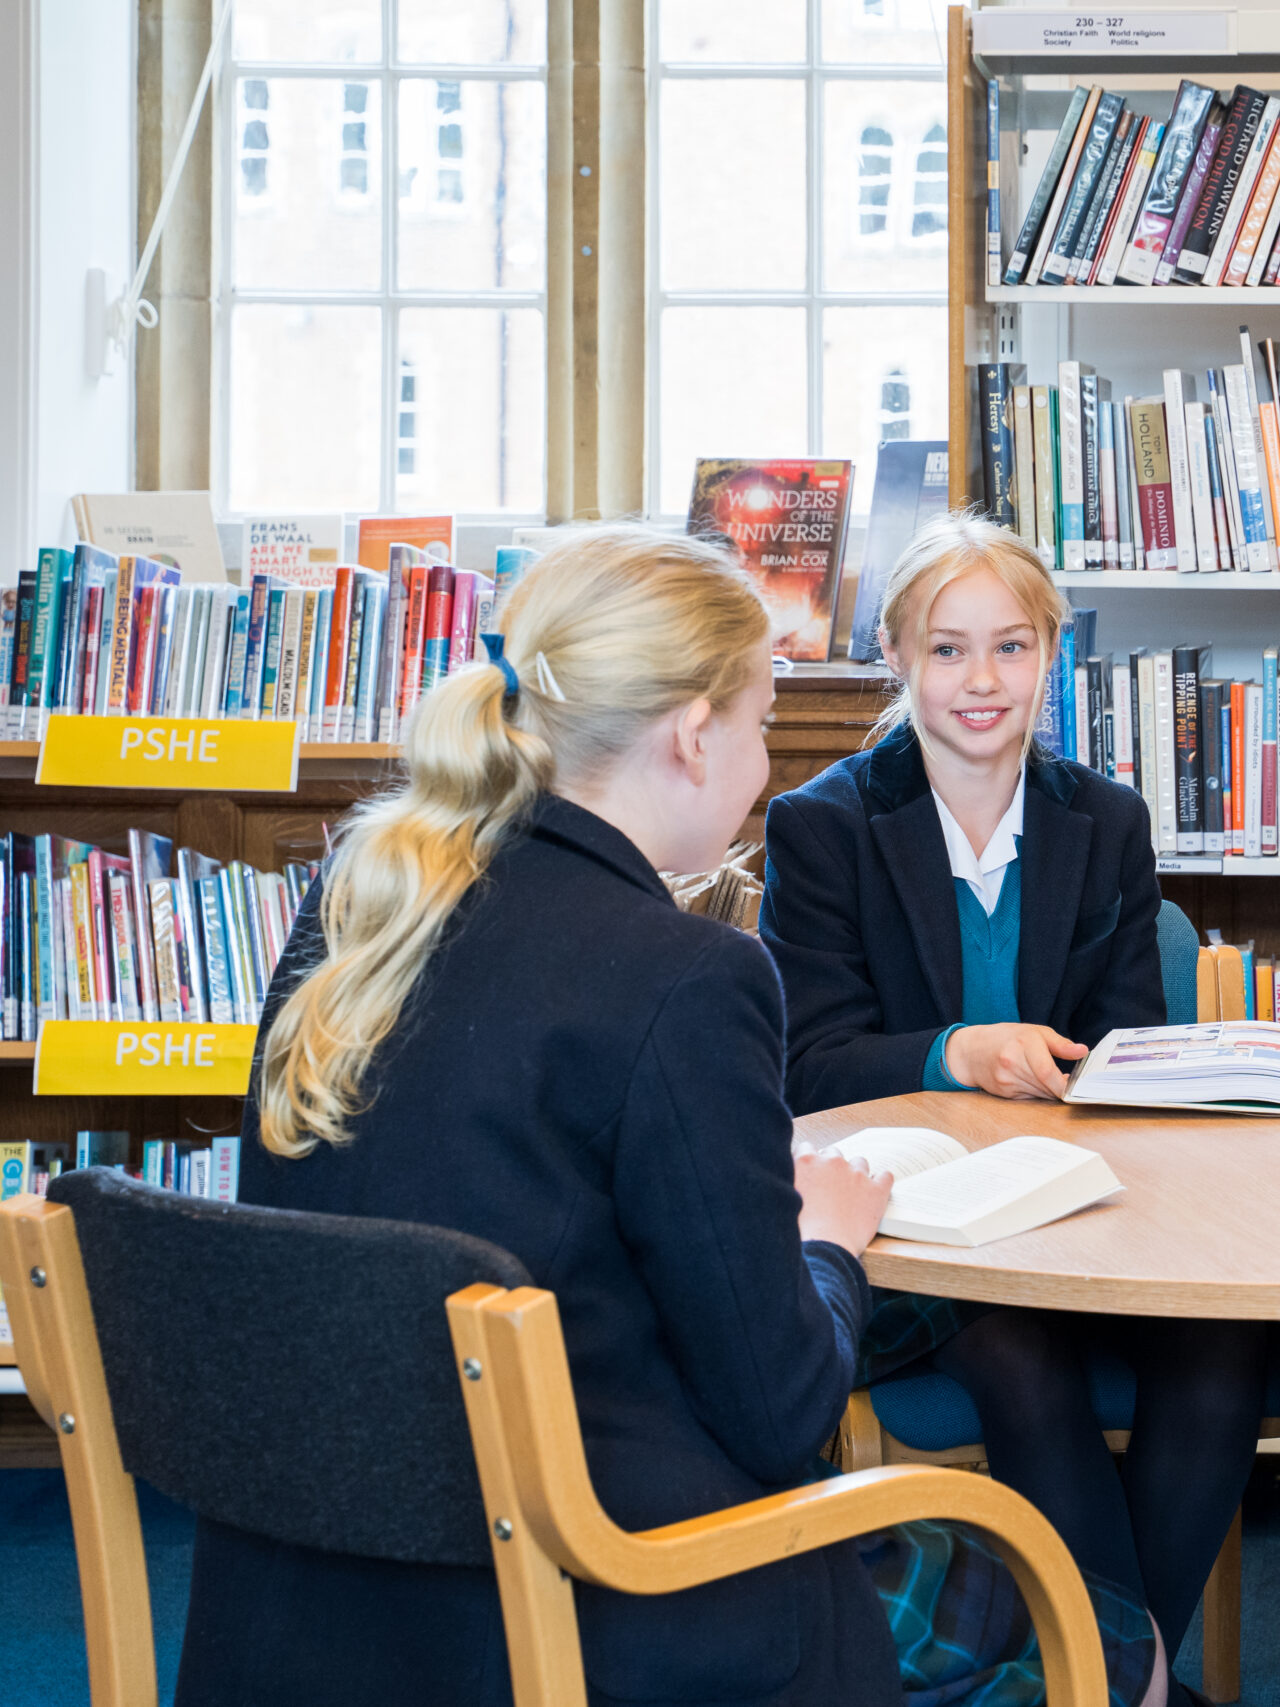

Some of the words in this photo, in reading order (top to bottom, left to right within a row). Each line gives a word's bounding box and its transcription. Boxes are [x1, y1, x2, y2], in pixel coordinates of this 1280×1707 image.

[1075, 18, 1094, 27] 230
[1106, 18, 1124, 27] 327
[1133, 30, 1165, 38] religions
[1044, 39, 1072, 47] Society
[1230, 91, 1250, 119] THE
[1216, 121, 1240, 158] GOD
[1229, 96, 1266, 166] RICHARD
[1190, 158, 1227, 231] DELUSION
[1205, 168, 1240, 237] DAWKINS
[986, 392, 1002, 434] Heresy
[1137, 413, 1154, 479] HOLLAND
[1152, 435, 1161, 455] TOM
[1084, 441, 1095, 490] CHRISTIAN
[790, 510, 808, 522] OF
[810, 510, 836, 522] THE
[1086, 491, 1097, 524] ETHICS
[251, 523, 297, 531] FRANS
[251, 534, 267, 544] DE
[275, 534, 312, 543] WAAL
[726, 523, 834, 542] UNIVERSE
[250, 556, 297, 565] SMART
[251, 545, 276, 554] ARE
[283, 545, 302, 554] WE
[760, 554, 798, 566] BRIAN
[801, 554, 828, 566] COX
[250, 567, 312, 576] ENOUGH
[318, 567, 336, 576] TO
[116, 598, 130, 635] BEING
[112, 638, 127, 685] MENTAL
[280, 649, 294, 690] MALCOLM
[1176, 673, 1186, 715] TIPPING
[1185, 672, 1197, 720] REVENGE
[1177, 717, 1188, 749] POINT
[1189, 722, 1196, 732] OF
[1189, 735, 1197, 749] THE
[120, 726, 221, 763] PSHE
[1179, 776, 1189, 823] Gladwell
[1188, 777, 1197, 822] Malcolm
[115, 1032, 216, 1066] PSHE
[3, 1148, 22, 1156] THE
